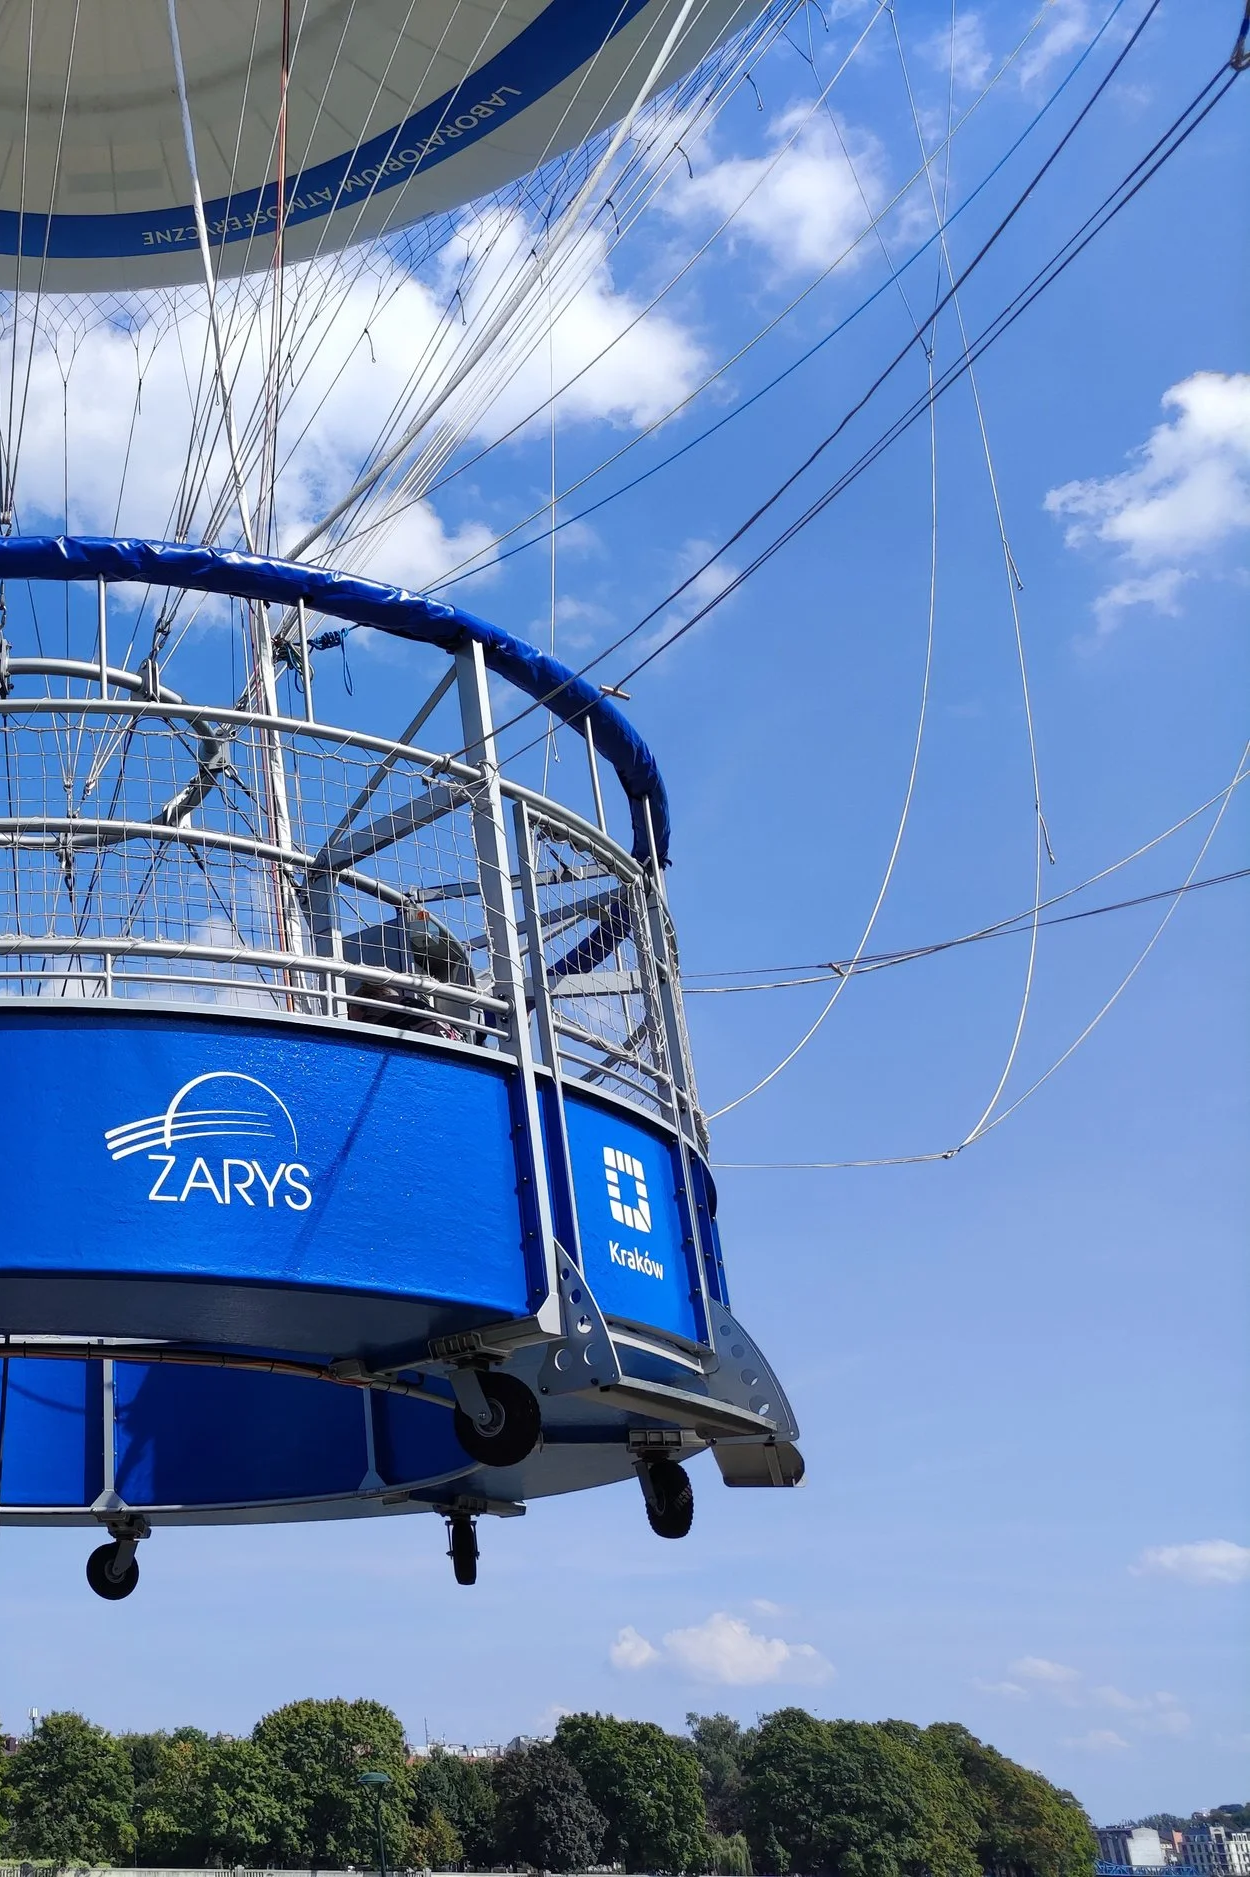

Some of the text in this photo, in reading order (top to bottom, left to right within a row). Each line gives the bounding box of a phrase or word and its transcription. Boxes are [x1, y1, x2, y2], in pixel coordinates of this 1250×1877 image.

[338, 85, 522, 193] LABORATORIUM
[148, 1153, 313, 1211] ZARYS
[608, 1239, 664, 1281] Kraków
